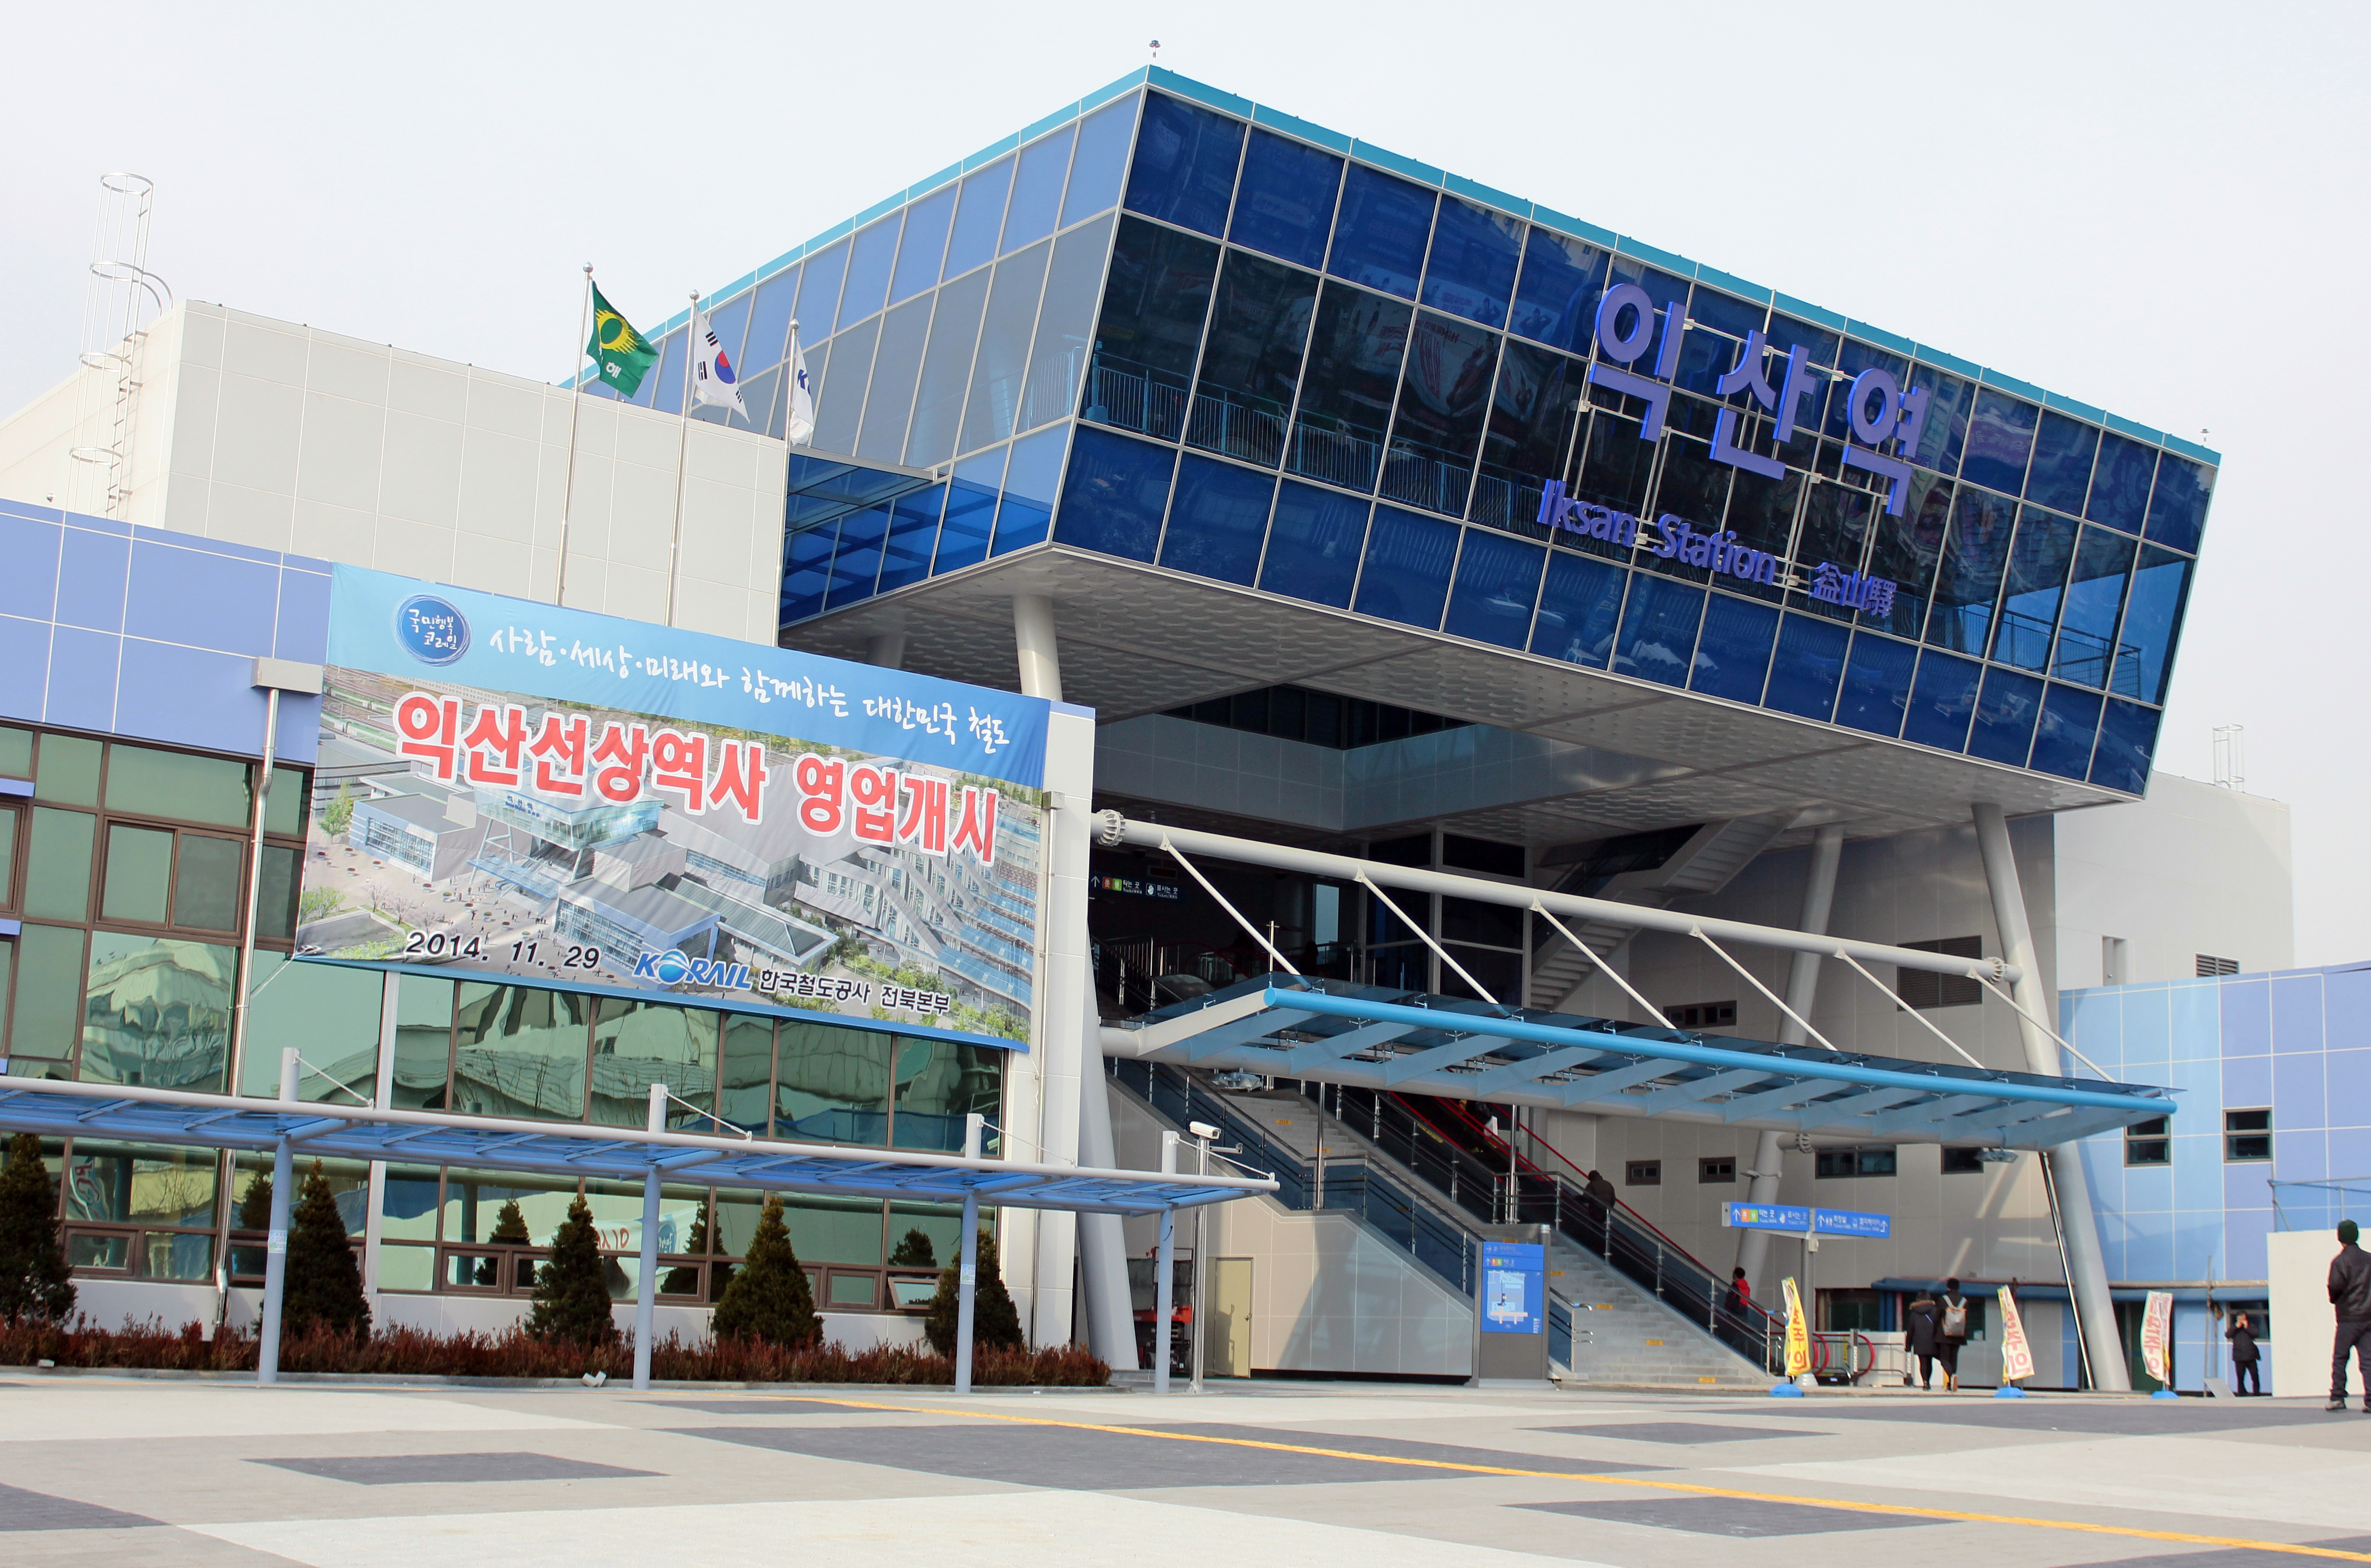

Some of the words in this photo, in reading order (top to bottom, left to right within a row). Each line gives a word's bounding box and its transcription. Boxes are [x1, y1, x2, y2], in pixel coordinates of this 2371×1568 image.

[1588, 283, 1929, 517] 익산역
[1537, 478, 1637, 547] Iksan
[1652, 513, 1776, 585] Station
[1809, 562, 1897, 619] 益山驛
[408, 608, 454, 635] 국민행복
[424, 631, 457, 650] 코레일
[741, 667, 849, 717] 함께하는
[863, 697, 957, 745] 대한민국
[969, 706, 1010, 754] 철도
[395, 694, 768, 822] 익산선상역사
[795, 755, 998, 865] 영업개시
[1123, 879, 1133, 888] 타는
[406, 932, 489, 962] 2014.
[512, 942, 545, 967] 11.
[564, 946, 599, 969] 29
[634, 950, 753, 990] KORAIL
[760, 969, 870, 1004] 한국철도공사
[881, 985, 950, 1014] 전북본부
